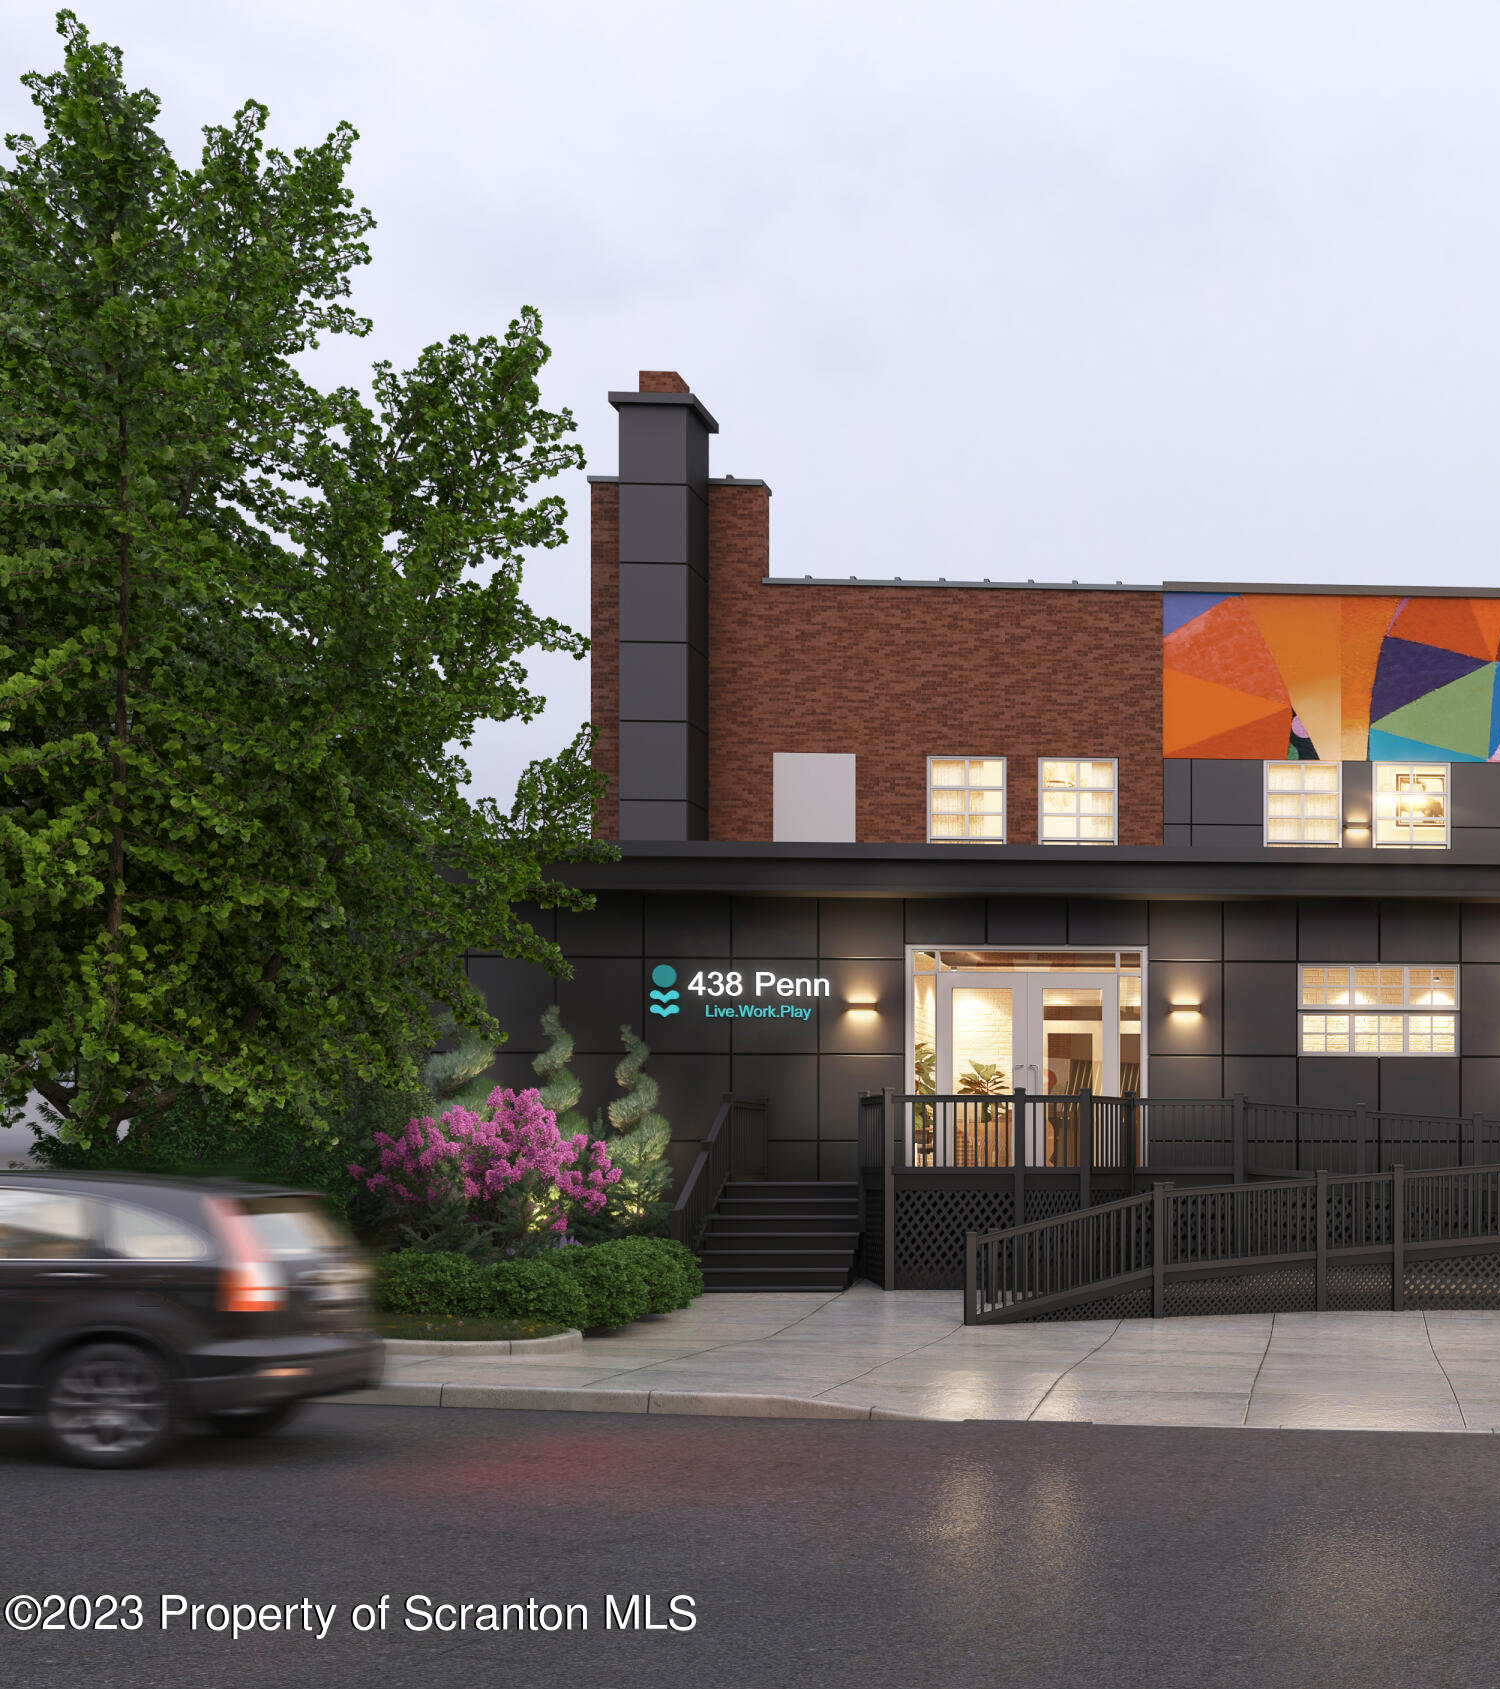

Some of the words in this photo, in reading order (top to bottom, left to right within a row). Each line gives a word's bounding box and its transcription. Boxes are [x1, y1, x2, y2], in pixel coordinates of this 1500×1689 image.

[687, 971, 744, 997] 438
[755, 971, 830, 997] Penn
[705, 1005, 812, 1021] Live.Work.Play
